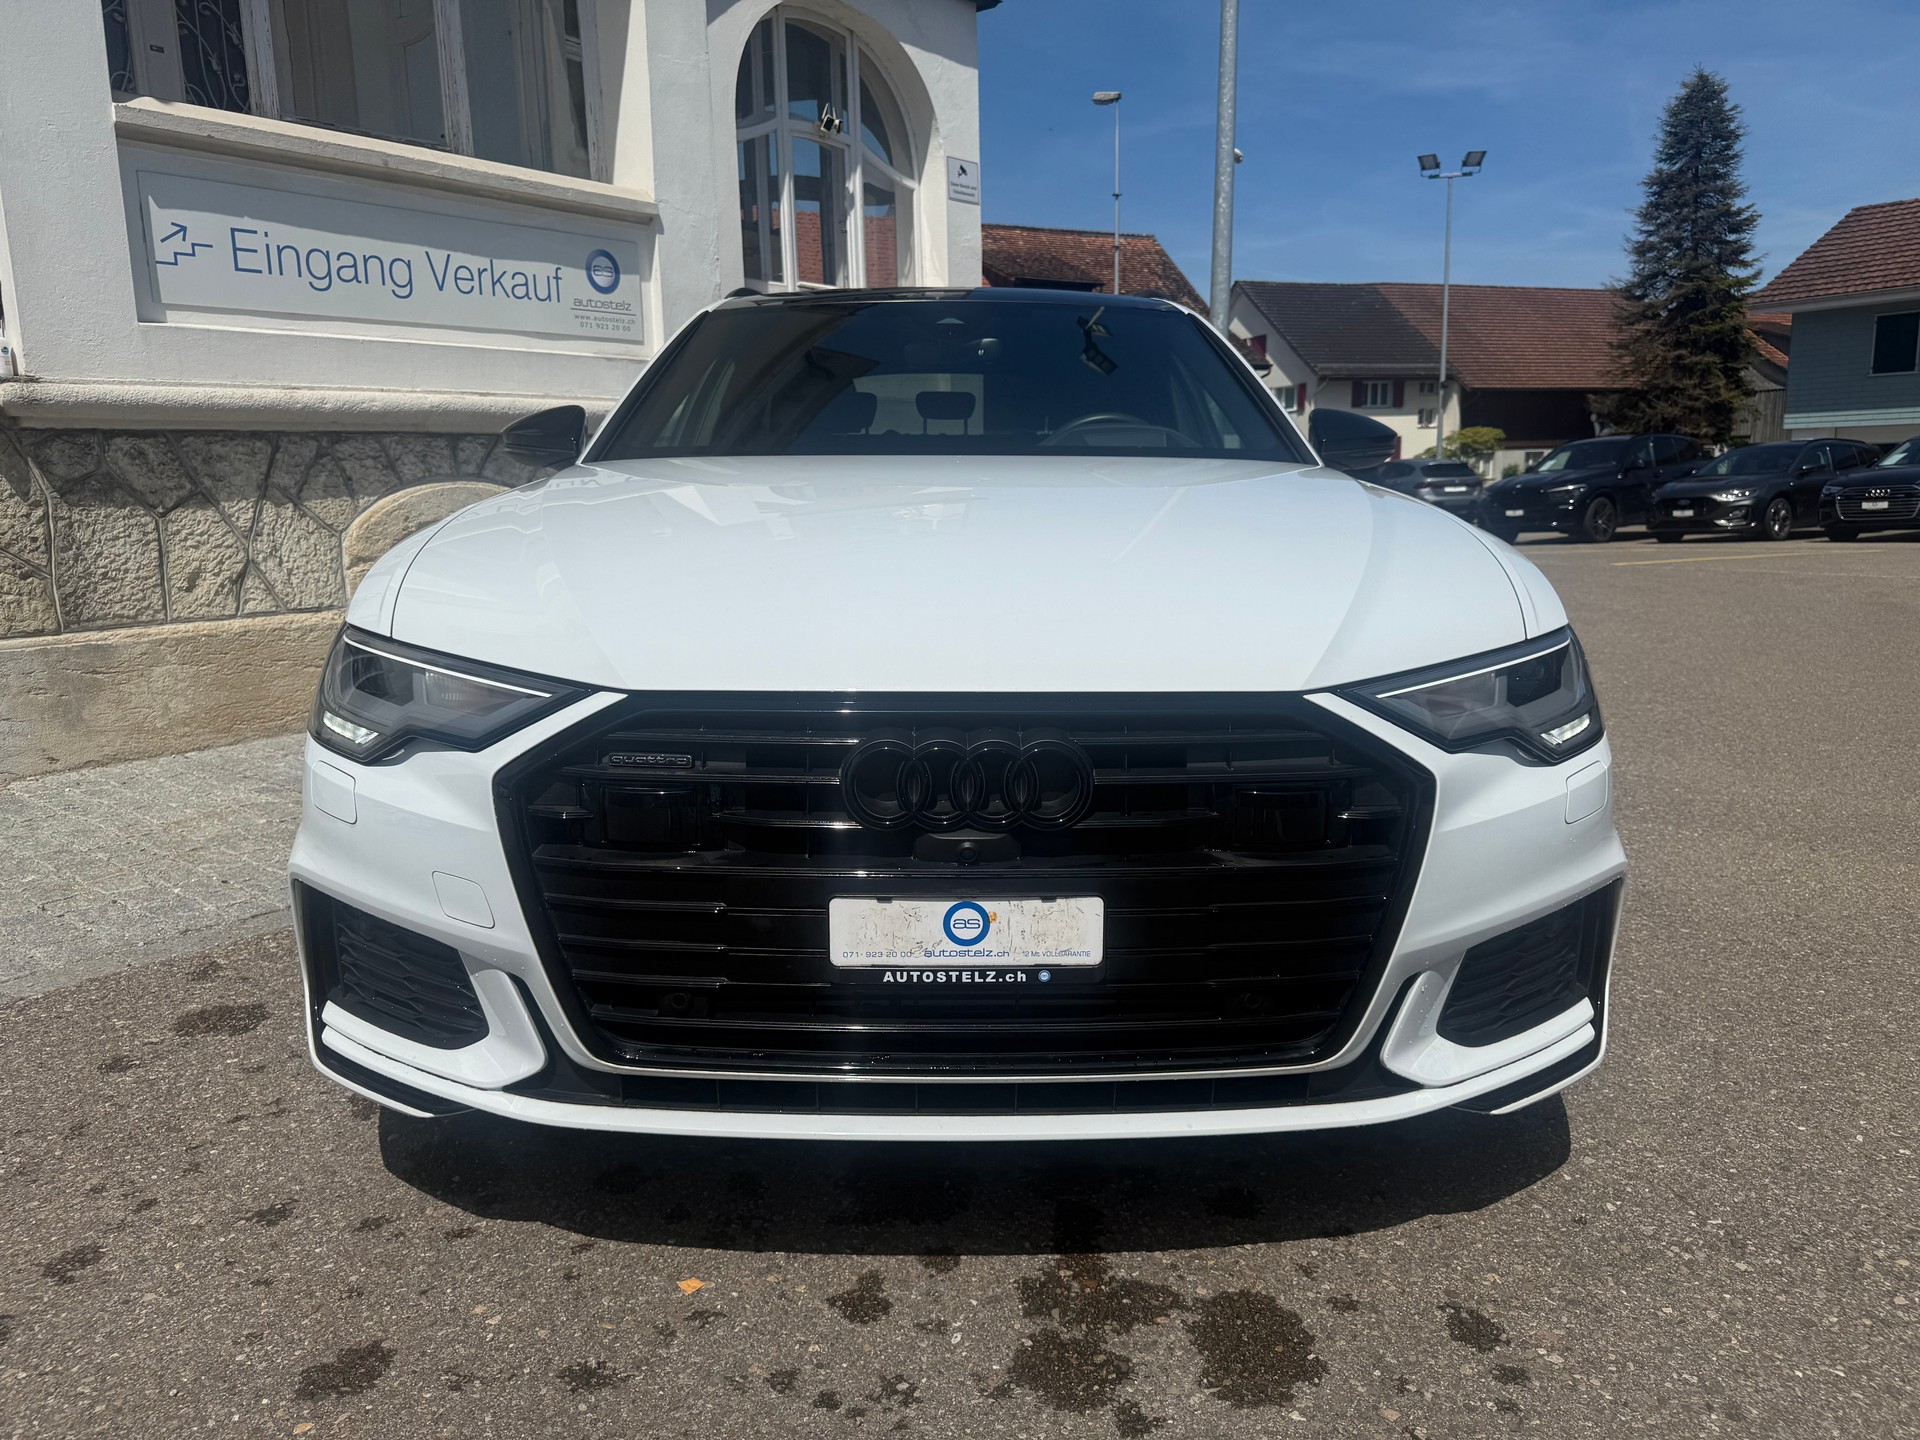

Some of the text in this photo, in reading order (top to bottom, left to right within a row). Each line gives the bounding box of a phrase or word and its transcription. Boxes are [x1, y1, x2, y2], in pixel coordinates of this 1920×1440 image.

[230, 227, 562, 303] Eingang Verkauf
[573, 298, 632, 311] autostelz
[574, 314, 636, 325] www.autostelz.ch
[612, 324, 620, 332] 20
[612, 756, 687, 764] quattro
[952, 918, 981, 930] as
[924, 948, 1010, 958] autostelz.ch
[883, 971, 1027, 982] AUTOSTELZ.ch
